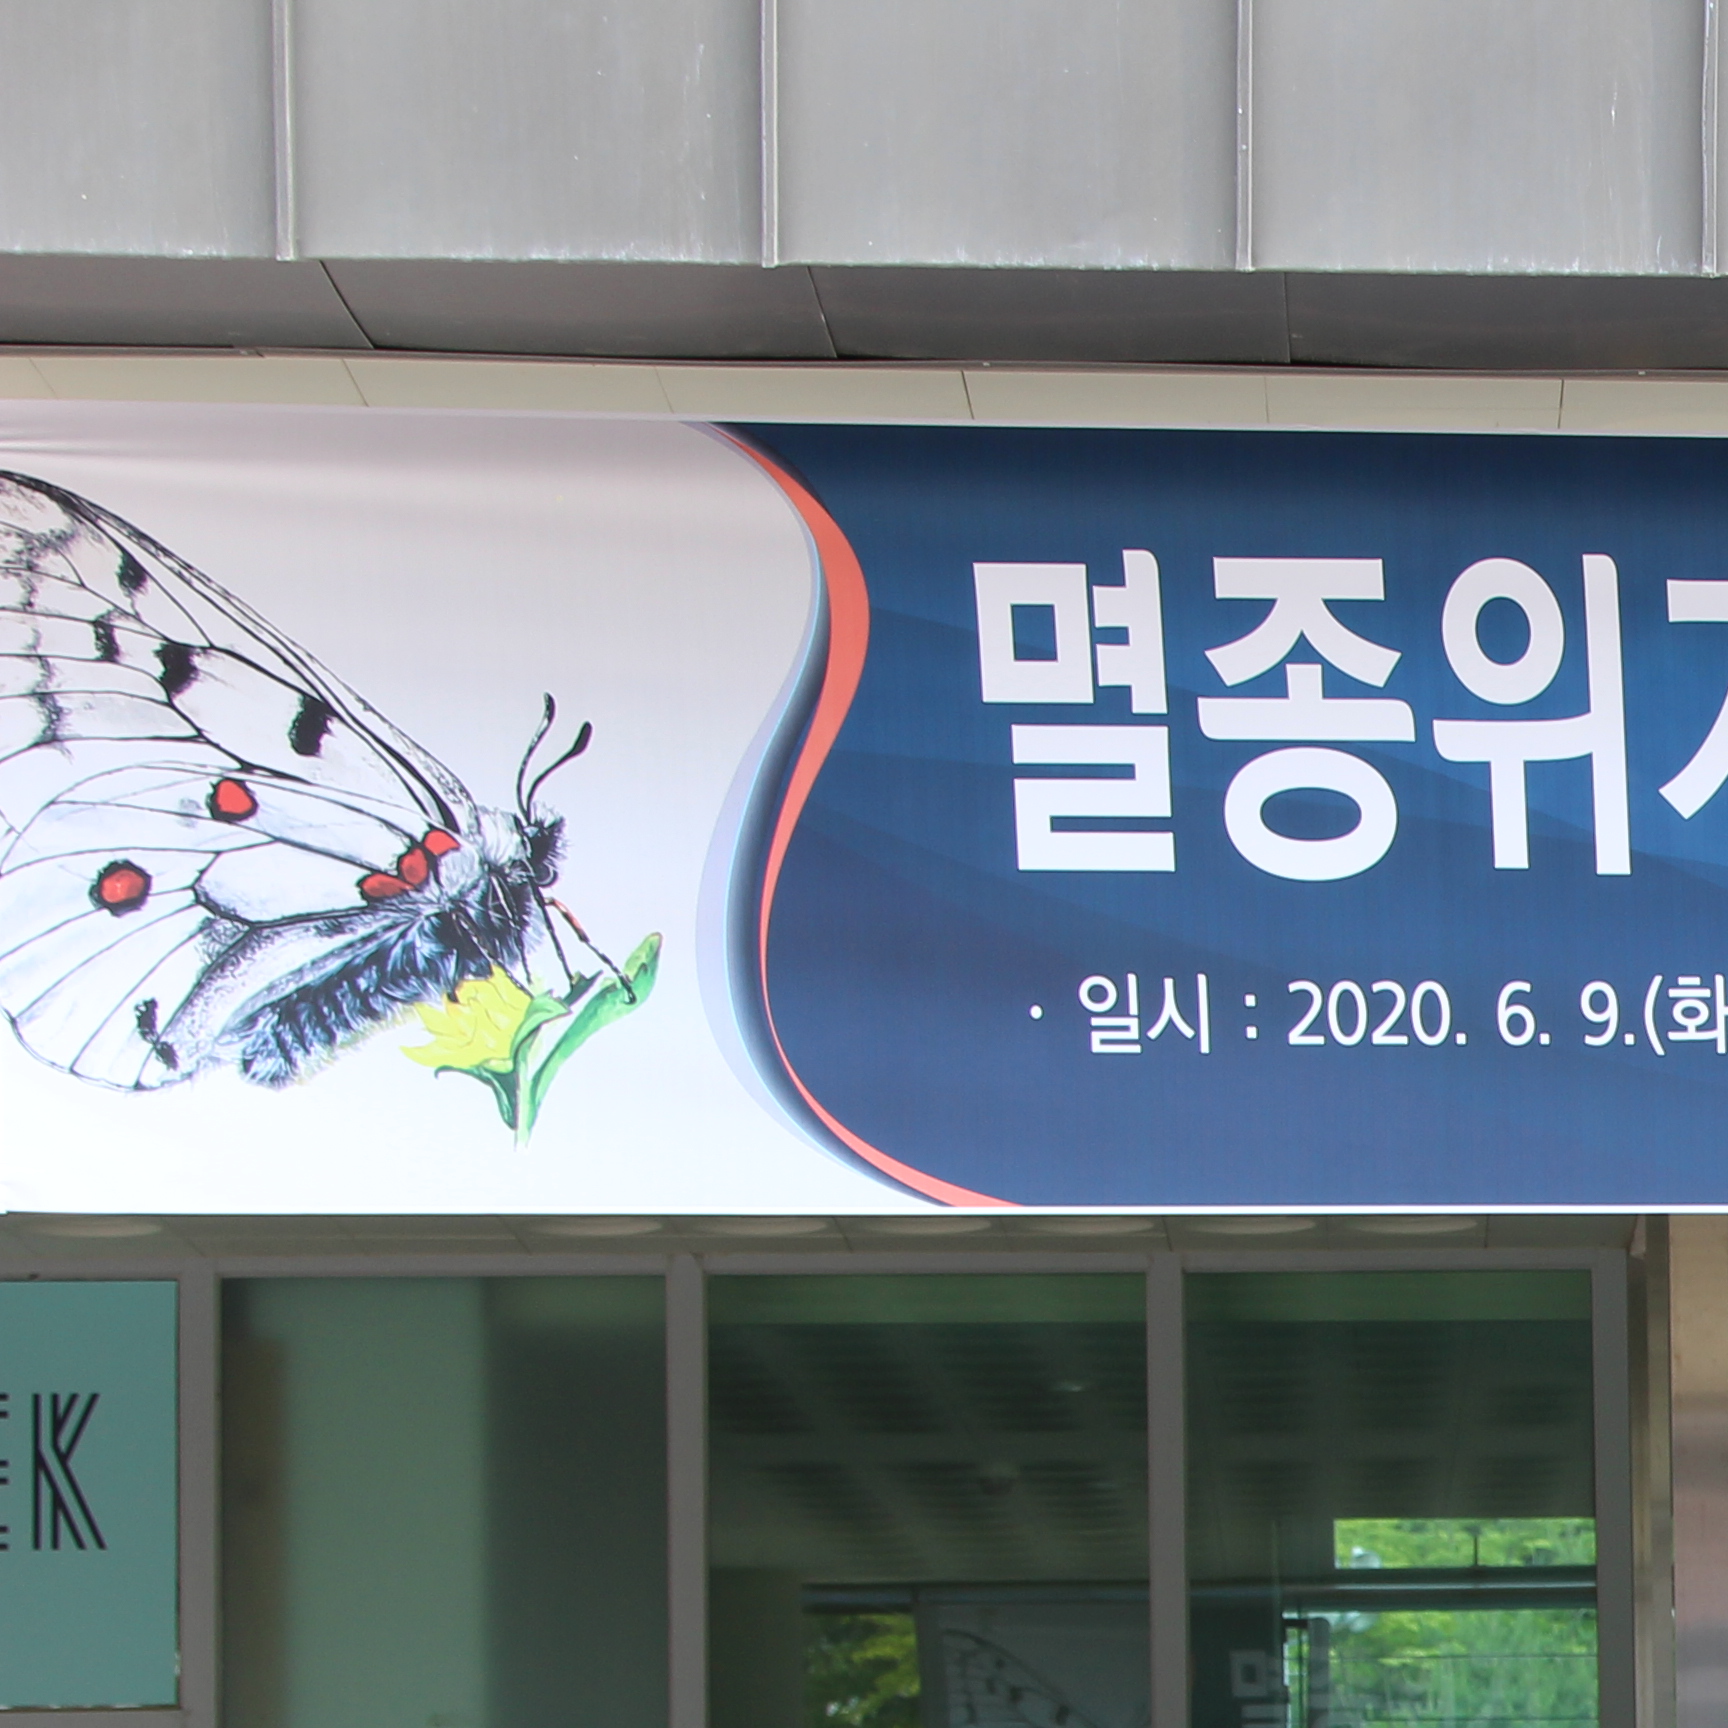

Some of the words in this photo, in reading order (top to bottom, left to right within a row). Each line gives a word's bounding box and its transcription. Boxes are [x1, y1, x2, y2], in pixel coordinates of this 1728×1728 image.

[1079, 974, 1209, 1053] 일시
[1289, 981, 1465, 1045] 2020.
[0, 1393, 107, 1550] K
